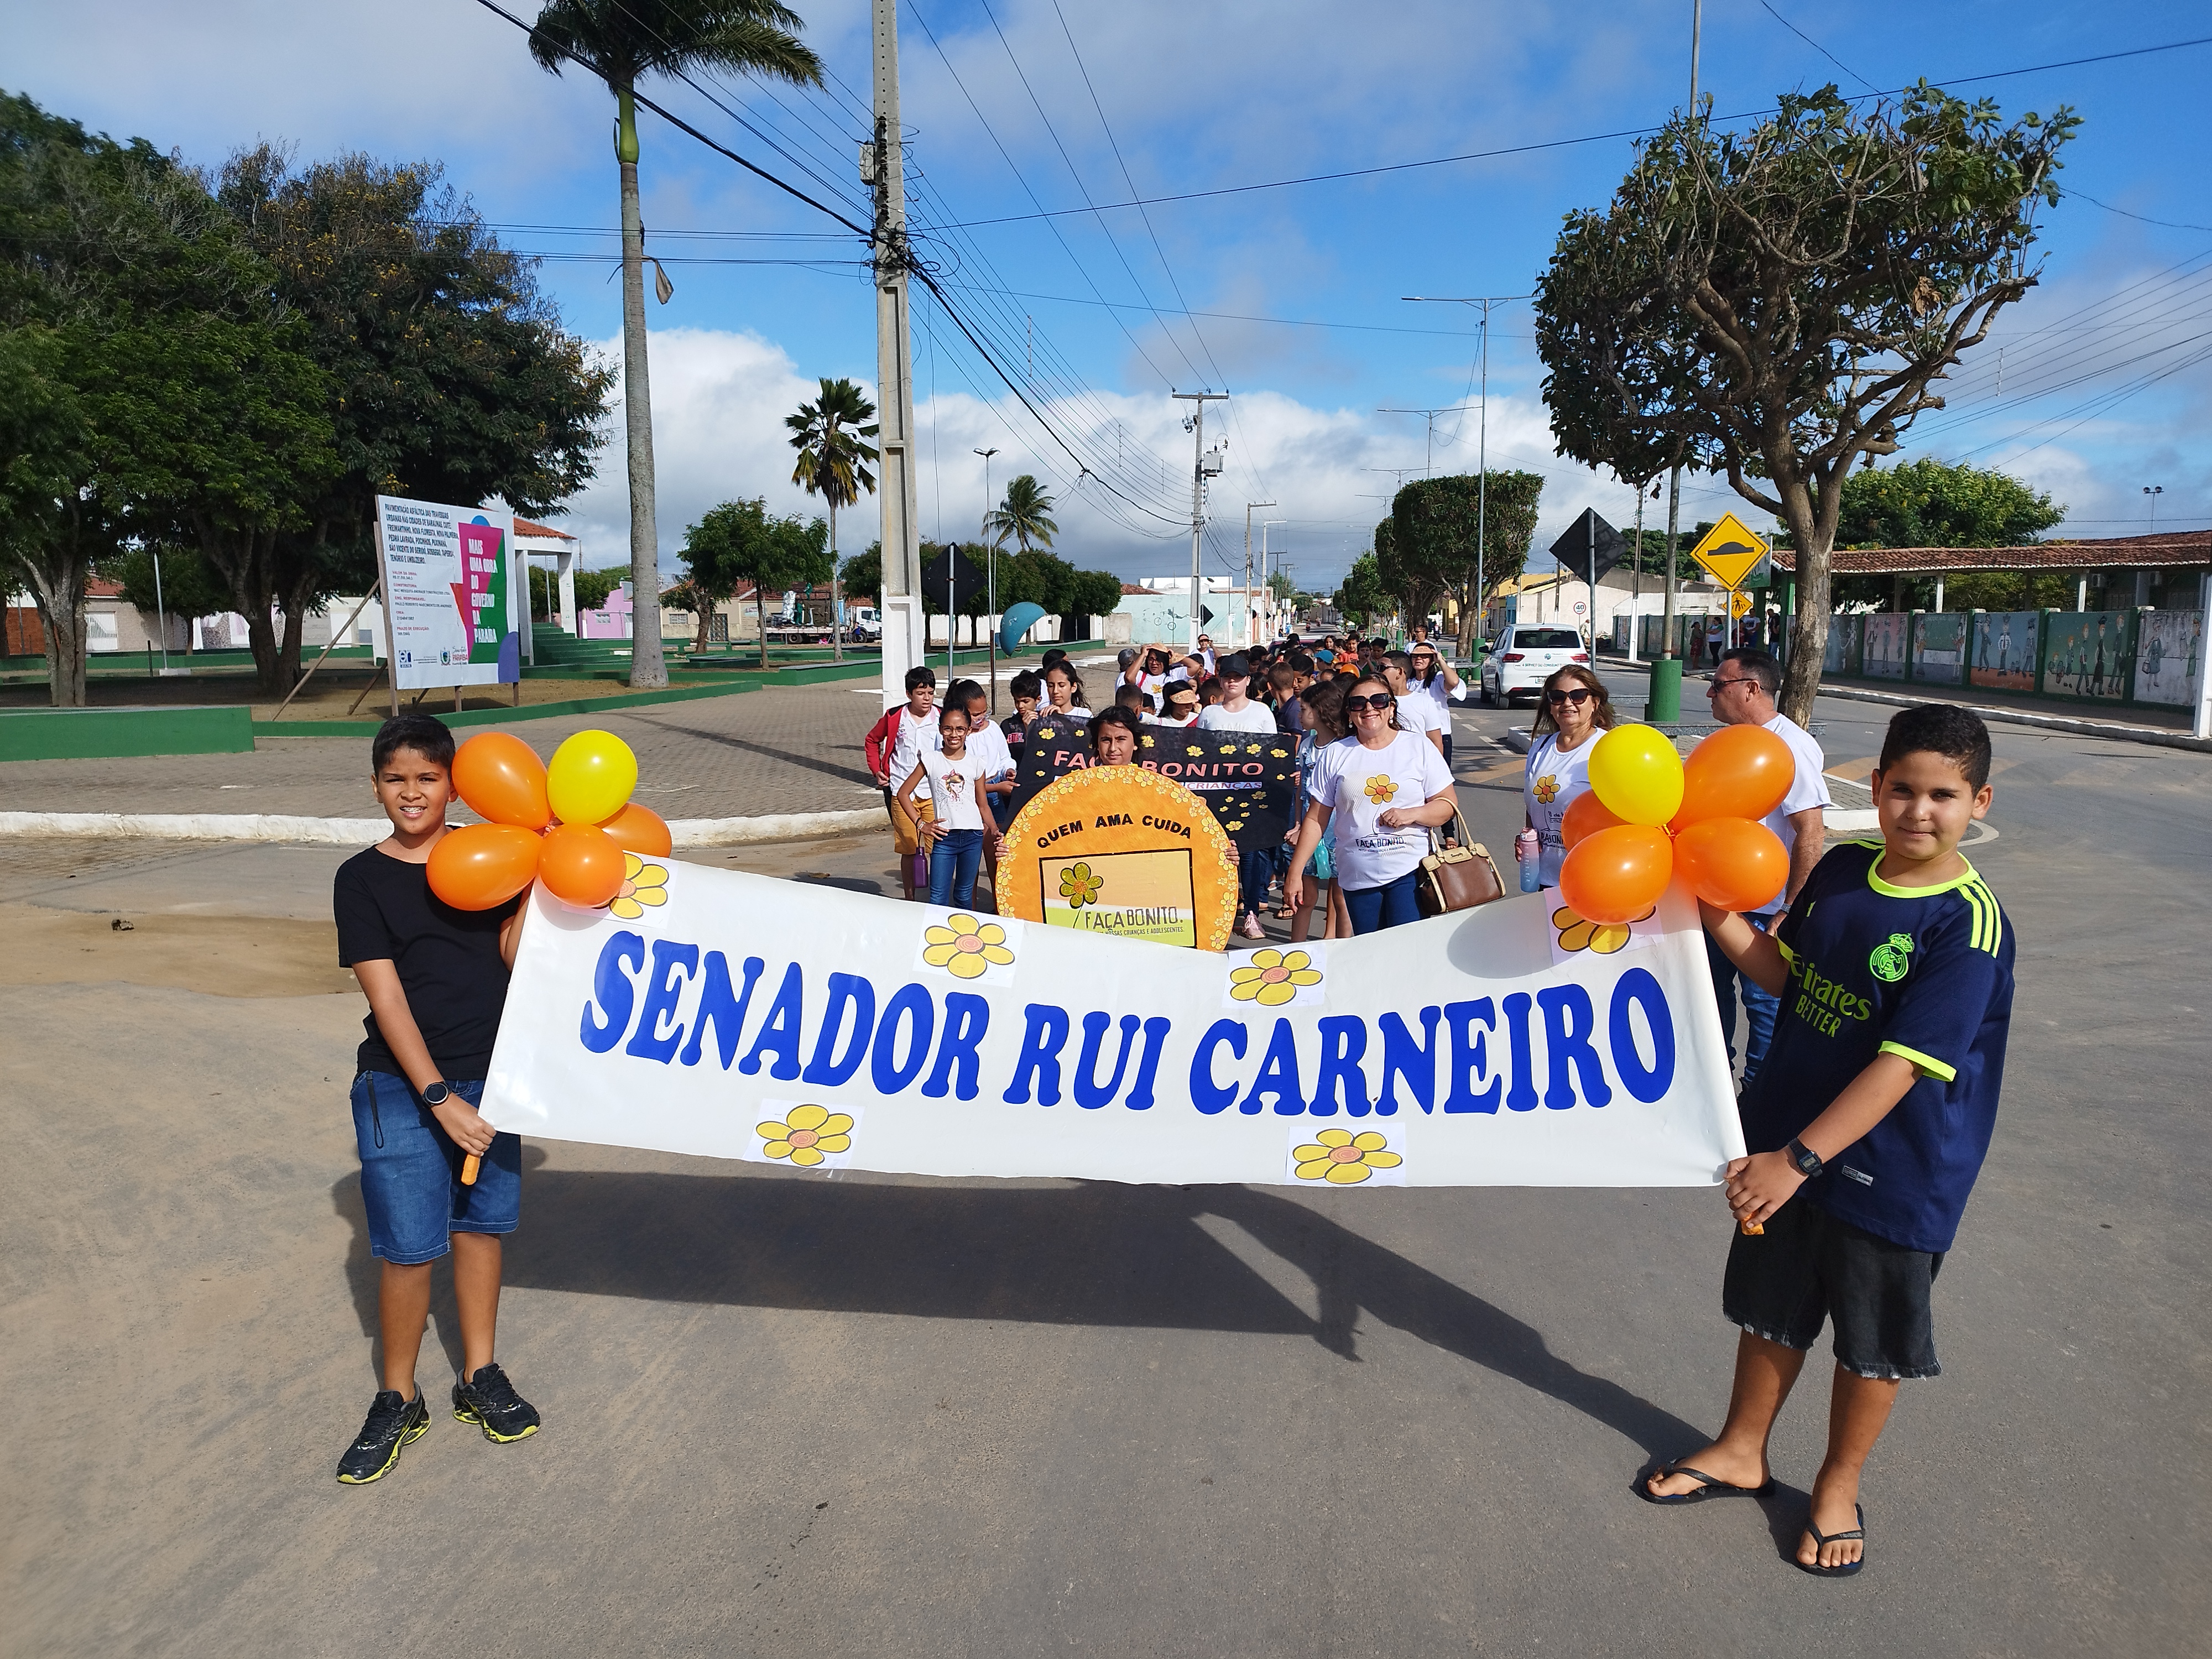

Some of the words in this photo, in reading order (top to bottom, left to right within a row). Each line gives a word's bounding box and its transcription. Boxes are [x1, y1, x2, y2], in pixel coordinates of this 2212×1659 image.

[409, 517, 421, 525] CIDADES
[388, 534, 399, 542] PEDRA
[396, 545, 409, 553] VICENTE
[468, 539, 483, 555] MAIS
[469, 557, 483, 572] UMA
[483, 558, 498, 573] OBRA
[471, 575, 479, 589] DO
[472, 592, 495, 607] GOVERNO
[472, 610, 481, 624] DA
[1142, 760, 1264, 778] BONITO
[1037, 820, 1084, 848] QUEM
[1095, 813, 1133, 828] AMA
[1142, 815, 1191, 839] CUIDA
[1086, 911, 1125, 930] FAÇA
[1126, 906, 1184, 926] BONITO.
[580, 930, 990, 1102] SENADOR
[1002, 1003, 1171, 1111] RUI
[1190, 967, 1676, 1117] CARNEIRO
[1795, 994, 1841, 1038] BETTER
